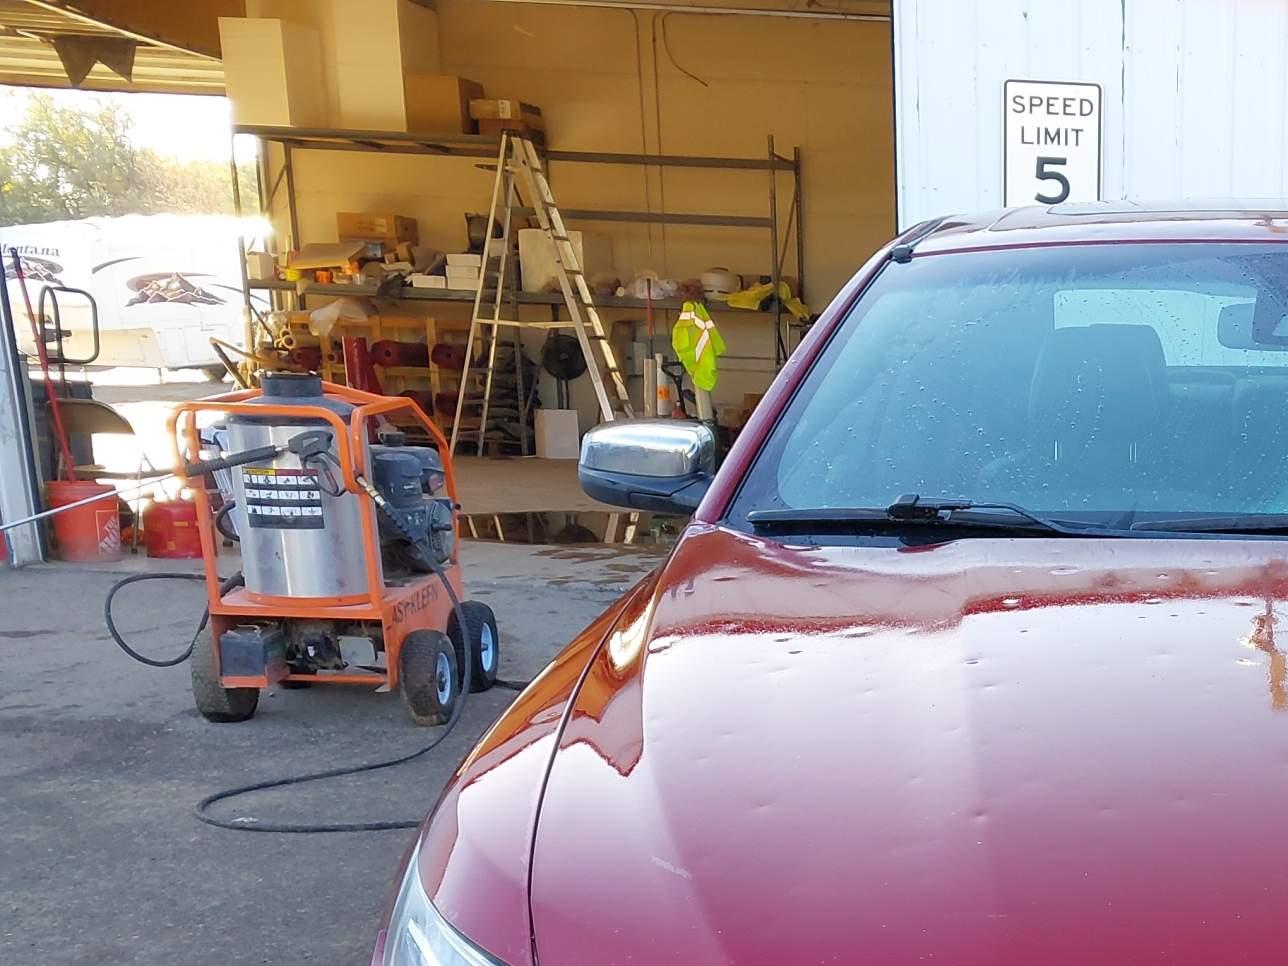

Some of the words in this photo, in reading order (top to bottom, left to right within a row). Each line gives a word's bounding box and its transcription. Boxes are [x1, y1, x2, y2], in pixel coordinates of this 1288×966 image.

[1012, 95, 1094, 117] SPEED
[1021, 126, 1084, 147] LIMIT
[1034, 156, 1071, 205] 5
